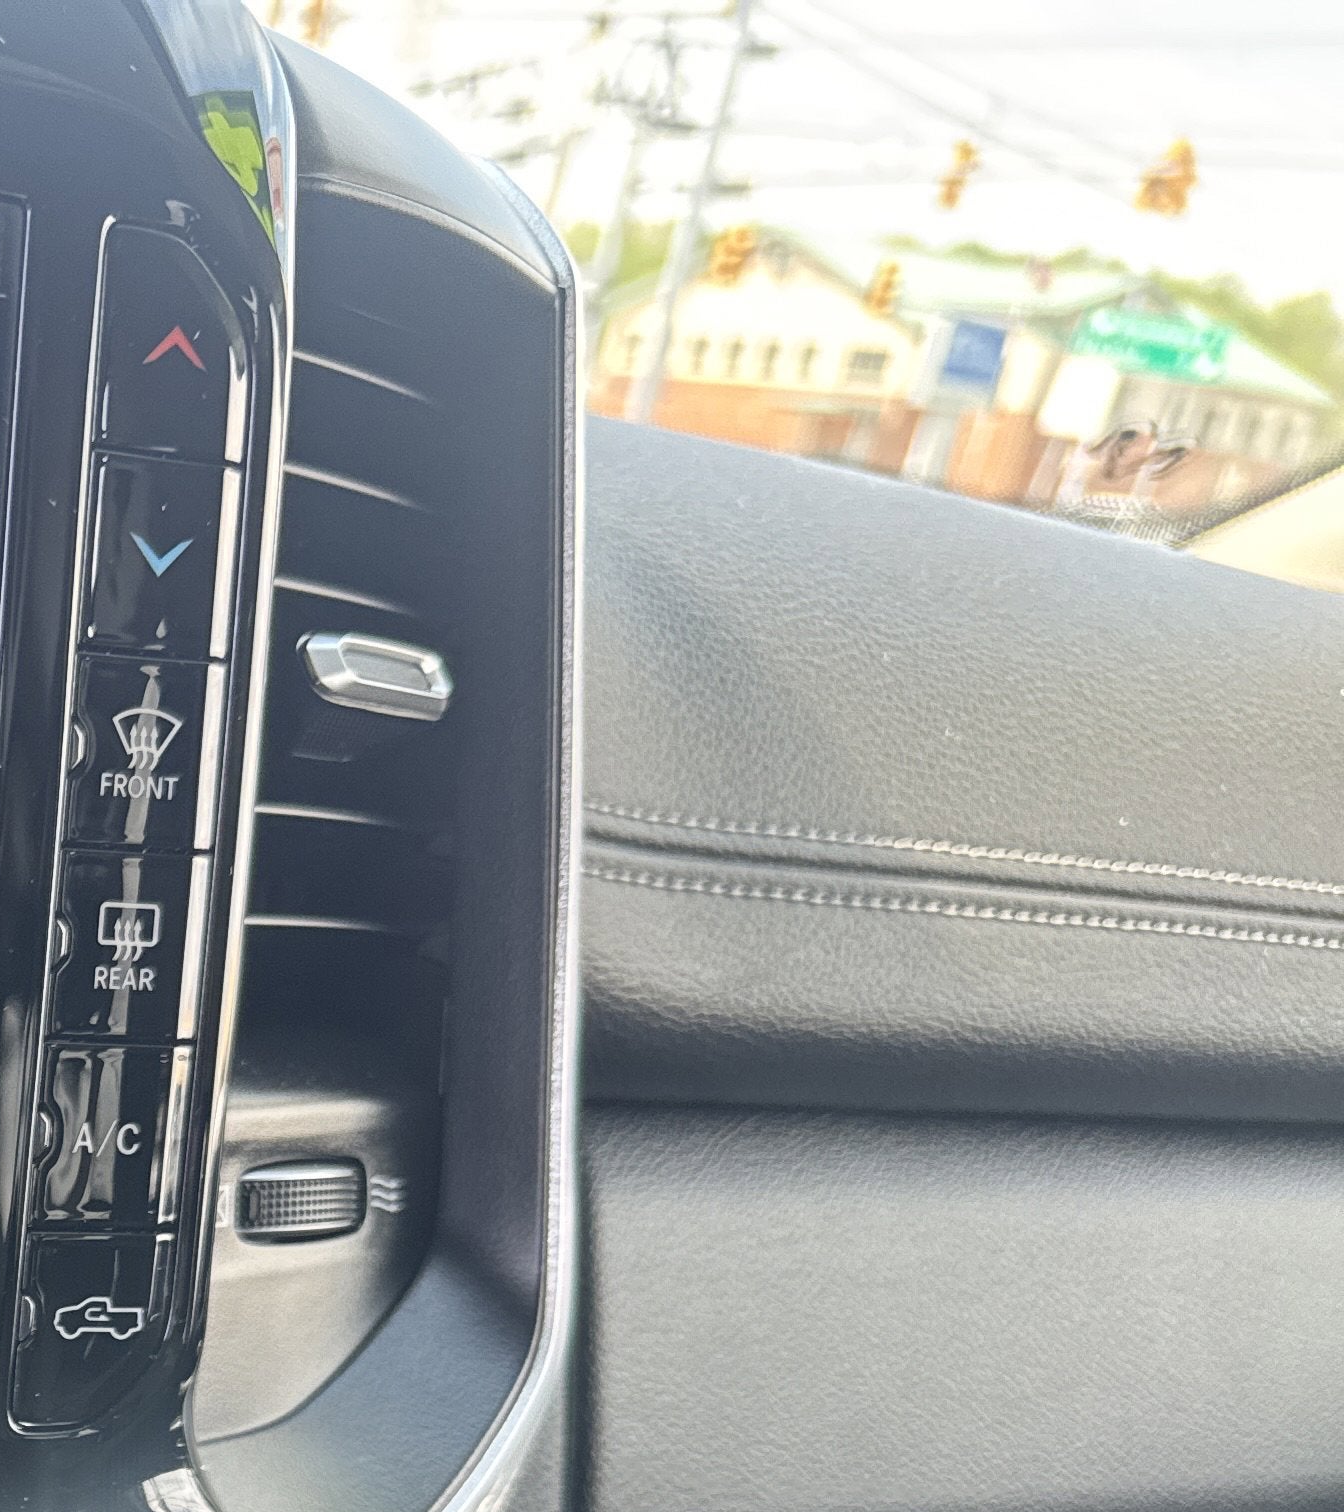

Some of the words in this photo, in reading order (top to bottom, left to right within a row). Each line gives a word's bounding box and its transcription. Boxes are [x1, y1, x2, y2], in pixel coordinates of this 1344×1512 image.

[99, 772, 179, 800] FRONT
[94, 966, 156, 991] REAR
[71, 1120, 141, 1157] A/C
